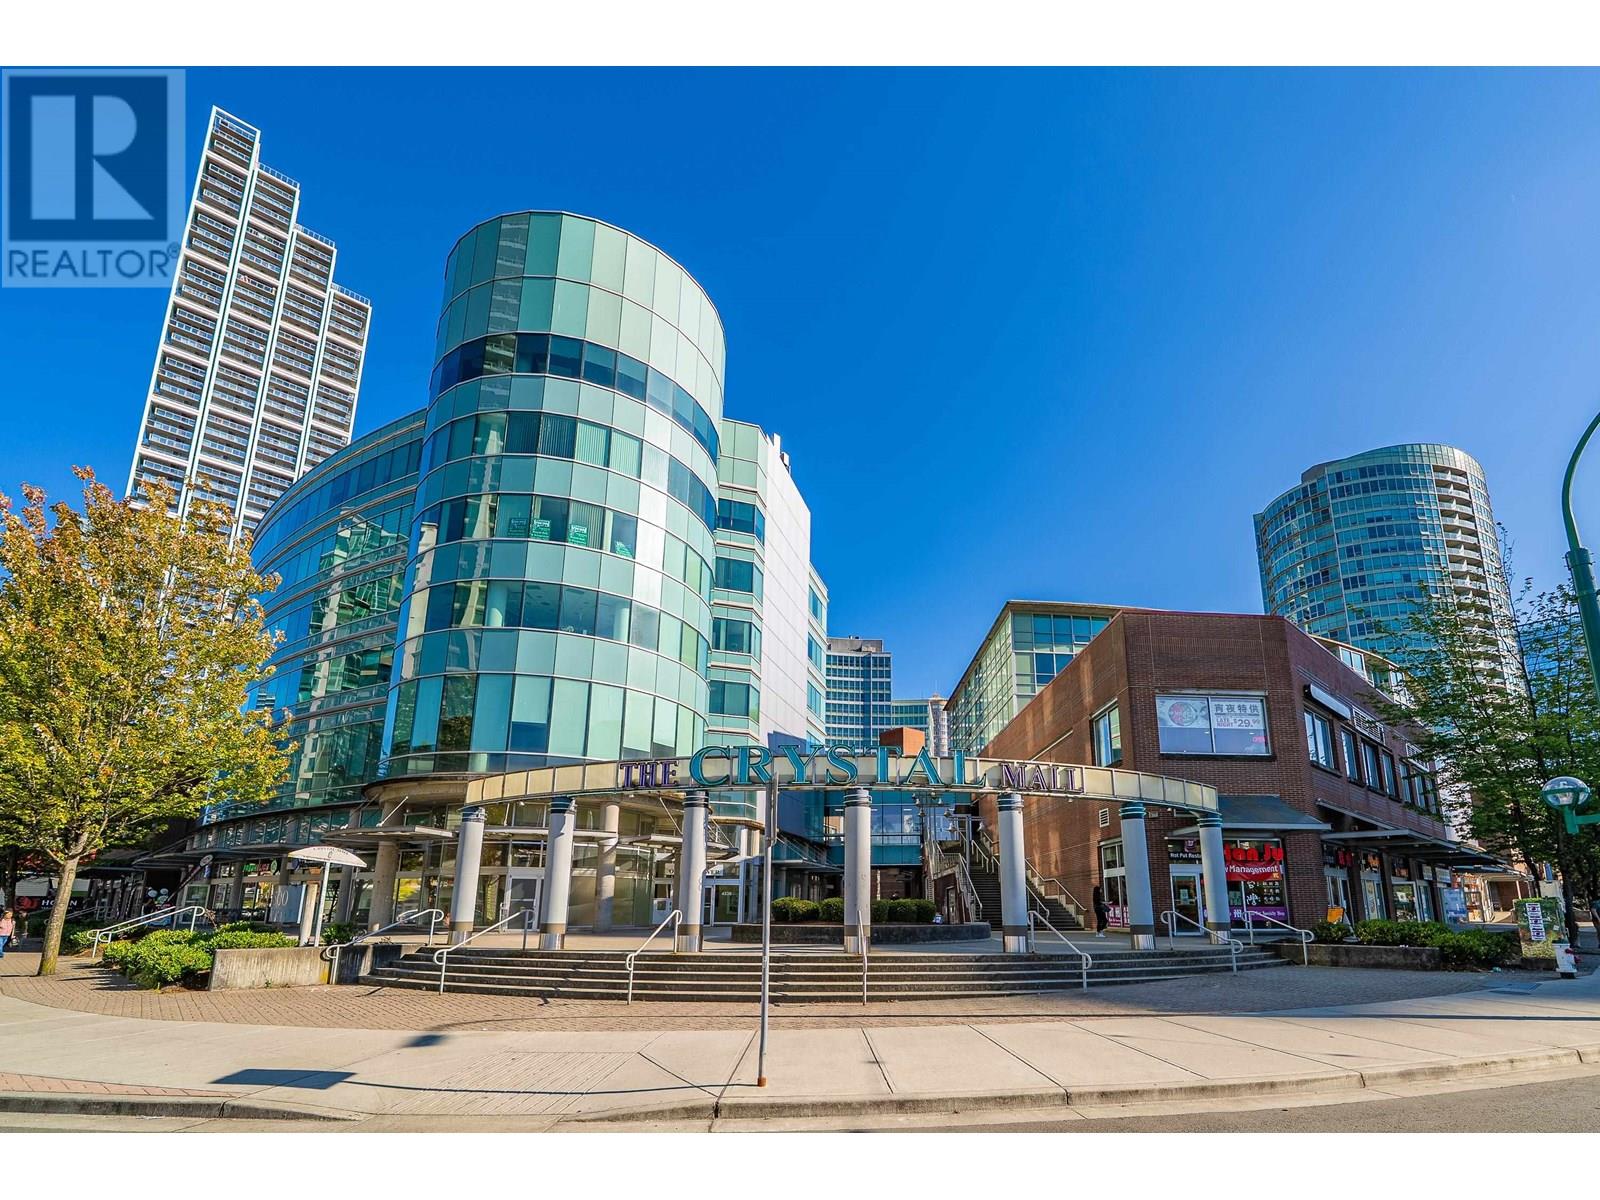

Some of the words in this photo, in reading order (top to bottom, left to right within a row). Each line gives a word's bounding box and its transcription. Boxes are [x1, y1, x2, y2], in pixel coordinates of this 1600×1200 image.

[620, 760, 679, 789] THE
[689, 745, 987, 787] CRYSTAL
[1000, 763, 1085, 793] MALL
[1229, 865, 1279, 875] Management
